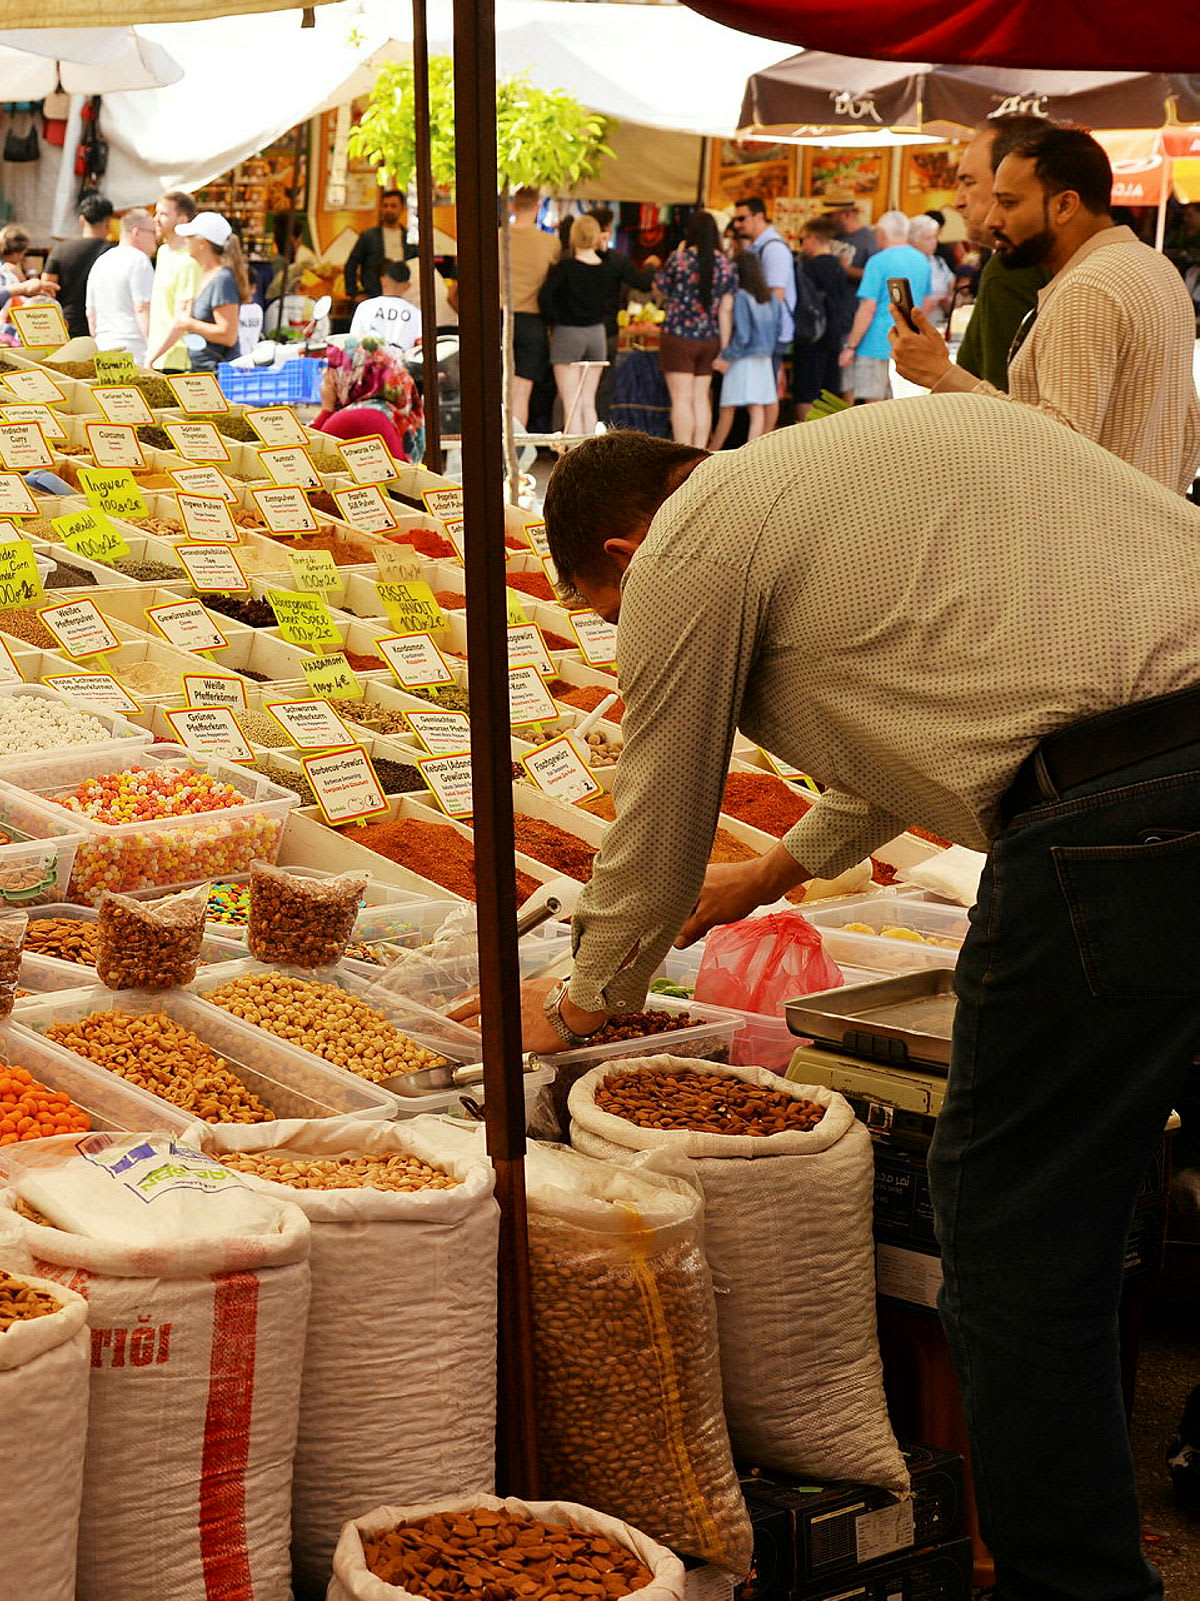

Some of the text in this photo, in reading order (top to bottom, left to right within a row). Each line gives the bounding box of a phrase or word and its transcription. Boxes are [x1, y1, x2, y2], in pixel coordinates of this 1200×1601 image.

[375, 307, 411, 321] ADO
[10, 435, 28, 443] Curry
[86, 475, 129, 497] Ingwer
[303, 519, 309, 528] 3
[10, 560, 30, 571] Corn
[204, 680, 226, 691] Weiße
[194, 691, 239, 703] Pfefferkörner
[188, 713, 216, 722] Grünes
[187, 723, 228, 733] Pfefferkorn
[310, 758, 365, 776] Barbecue-Gewürz
[440, 772, 471, 782] Gewürze
[584, 782, 593, 790] 2
